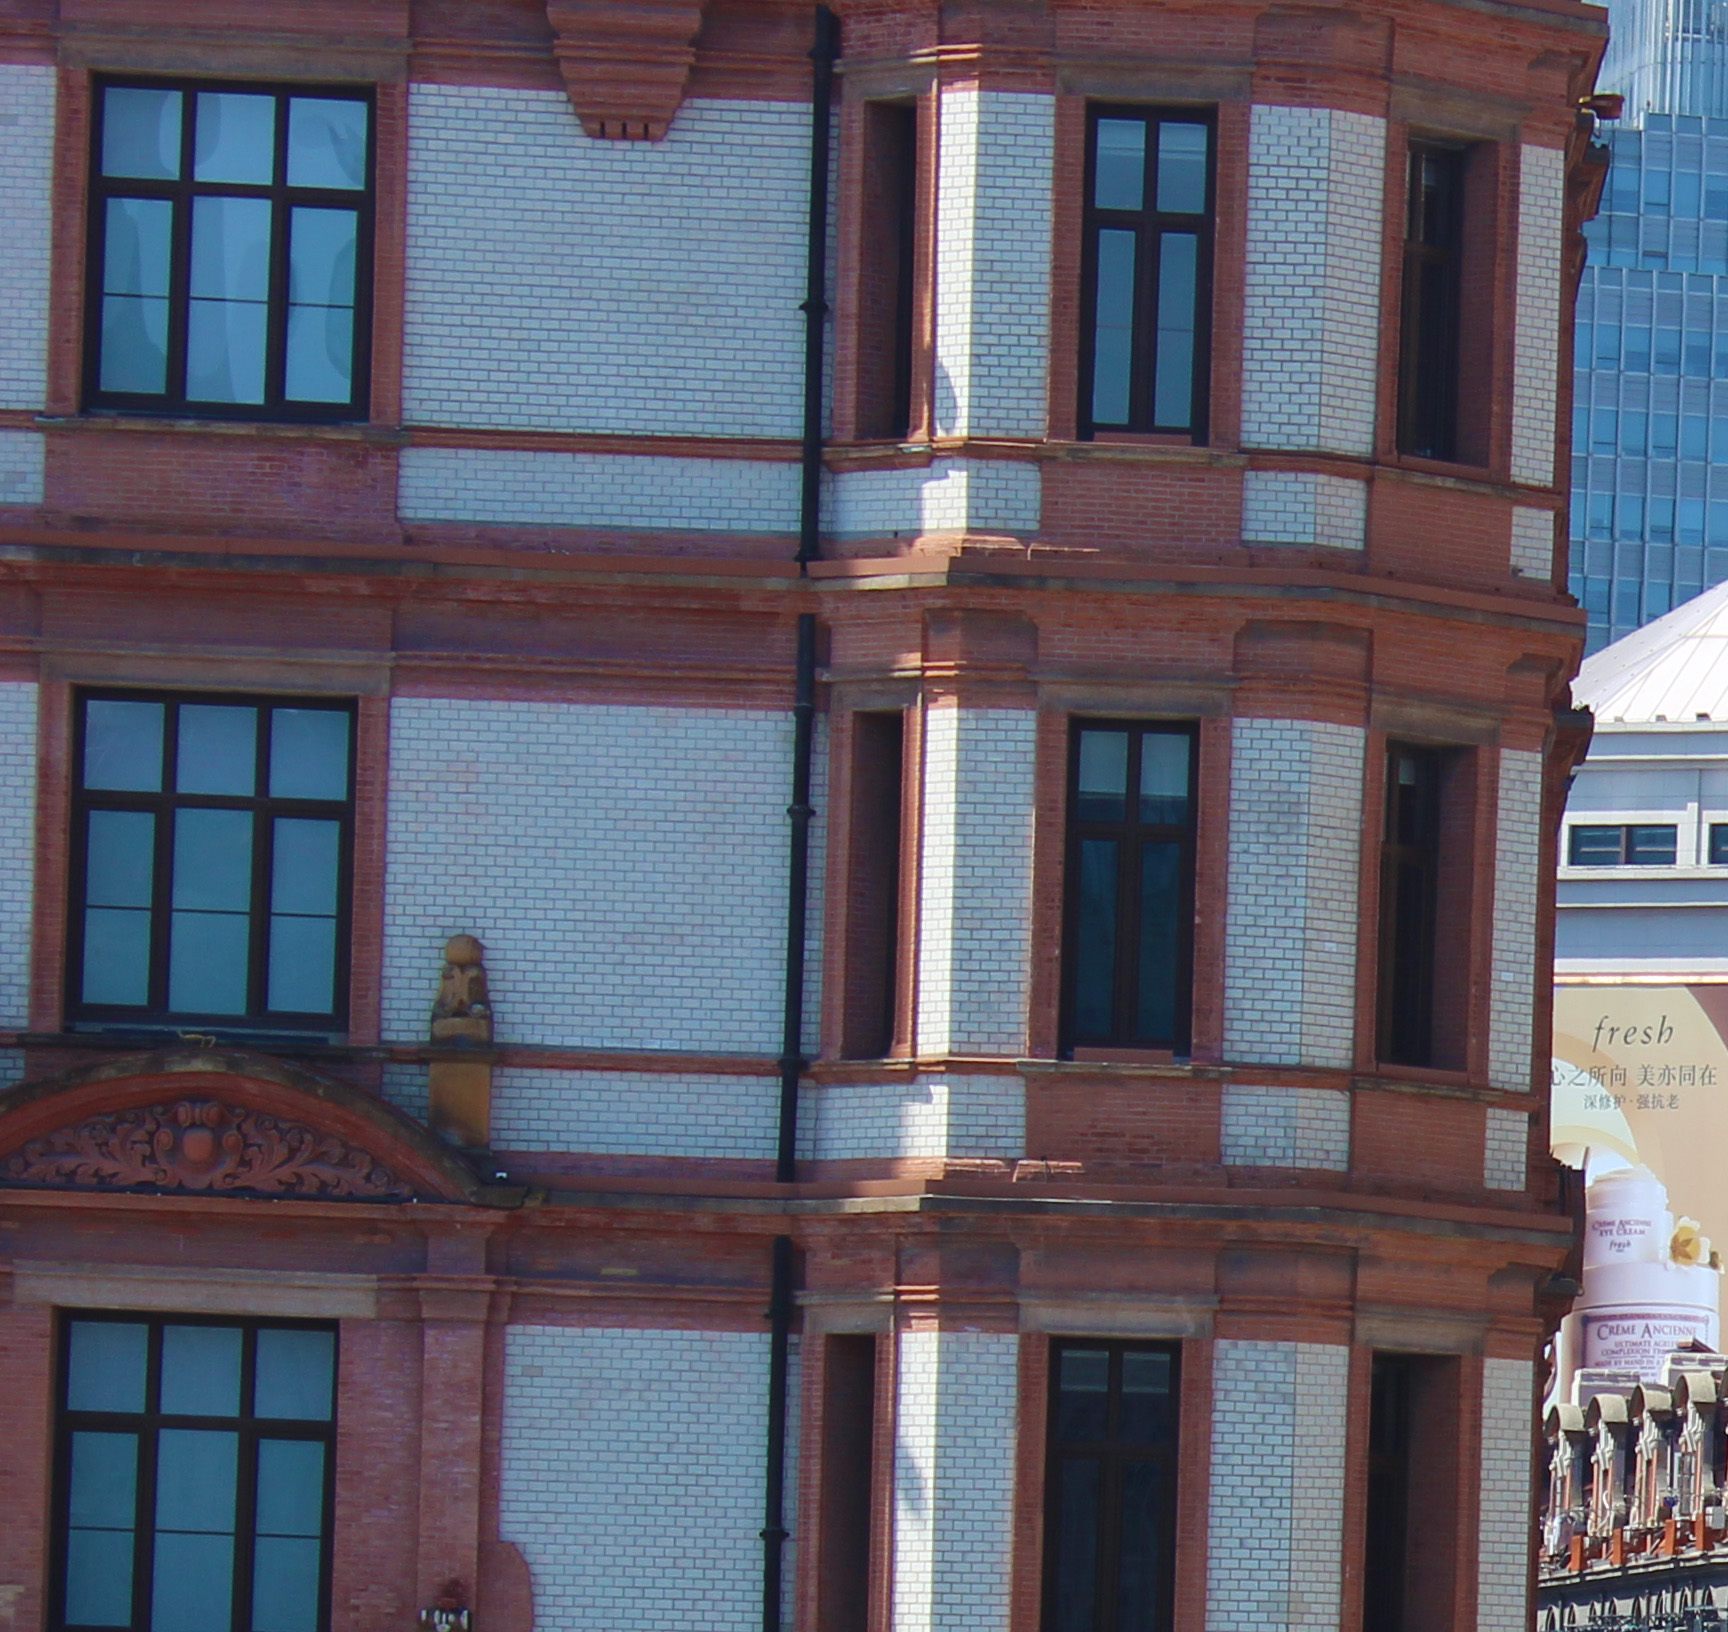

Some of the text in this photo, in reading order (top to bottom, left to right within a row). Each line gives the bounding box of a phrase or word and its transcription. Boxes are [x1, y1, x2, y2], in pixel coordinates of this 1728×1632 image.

[1592, 1015, 1674, 1053] fresh
[1550, 1064, 1718, 1087] 心之所向 美亦同在
